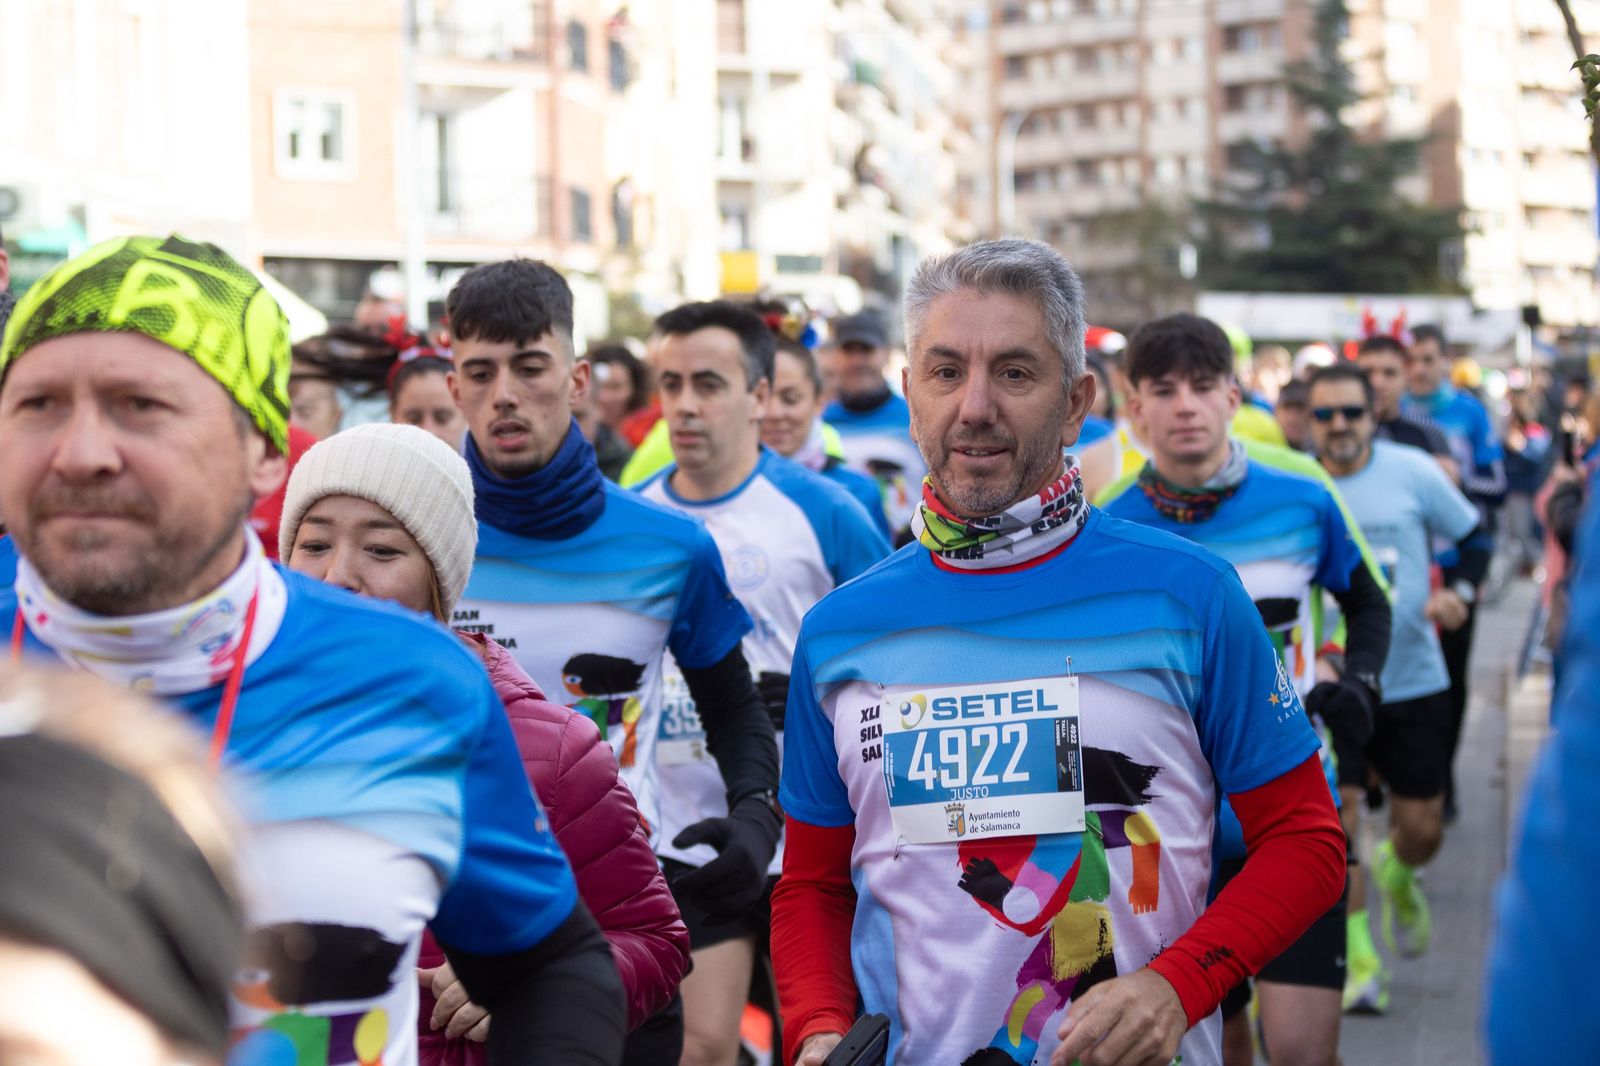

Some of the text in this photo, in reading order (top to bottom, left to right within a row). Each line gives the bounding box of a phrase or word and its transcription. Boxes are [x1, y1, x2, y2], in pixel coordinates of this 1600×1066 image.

[932, 689, 1058, 721] SETEL
[907, 722, 1029, 790] 4922
[949, 786, 989, 800] JUSTO
[968, 809, 1021, 822] Ayuntamiento
[970, 821, 1021, 834] de Salamanca
